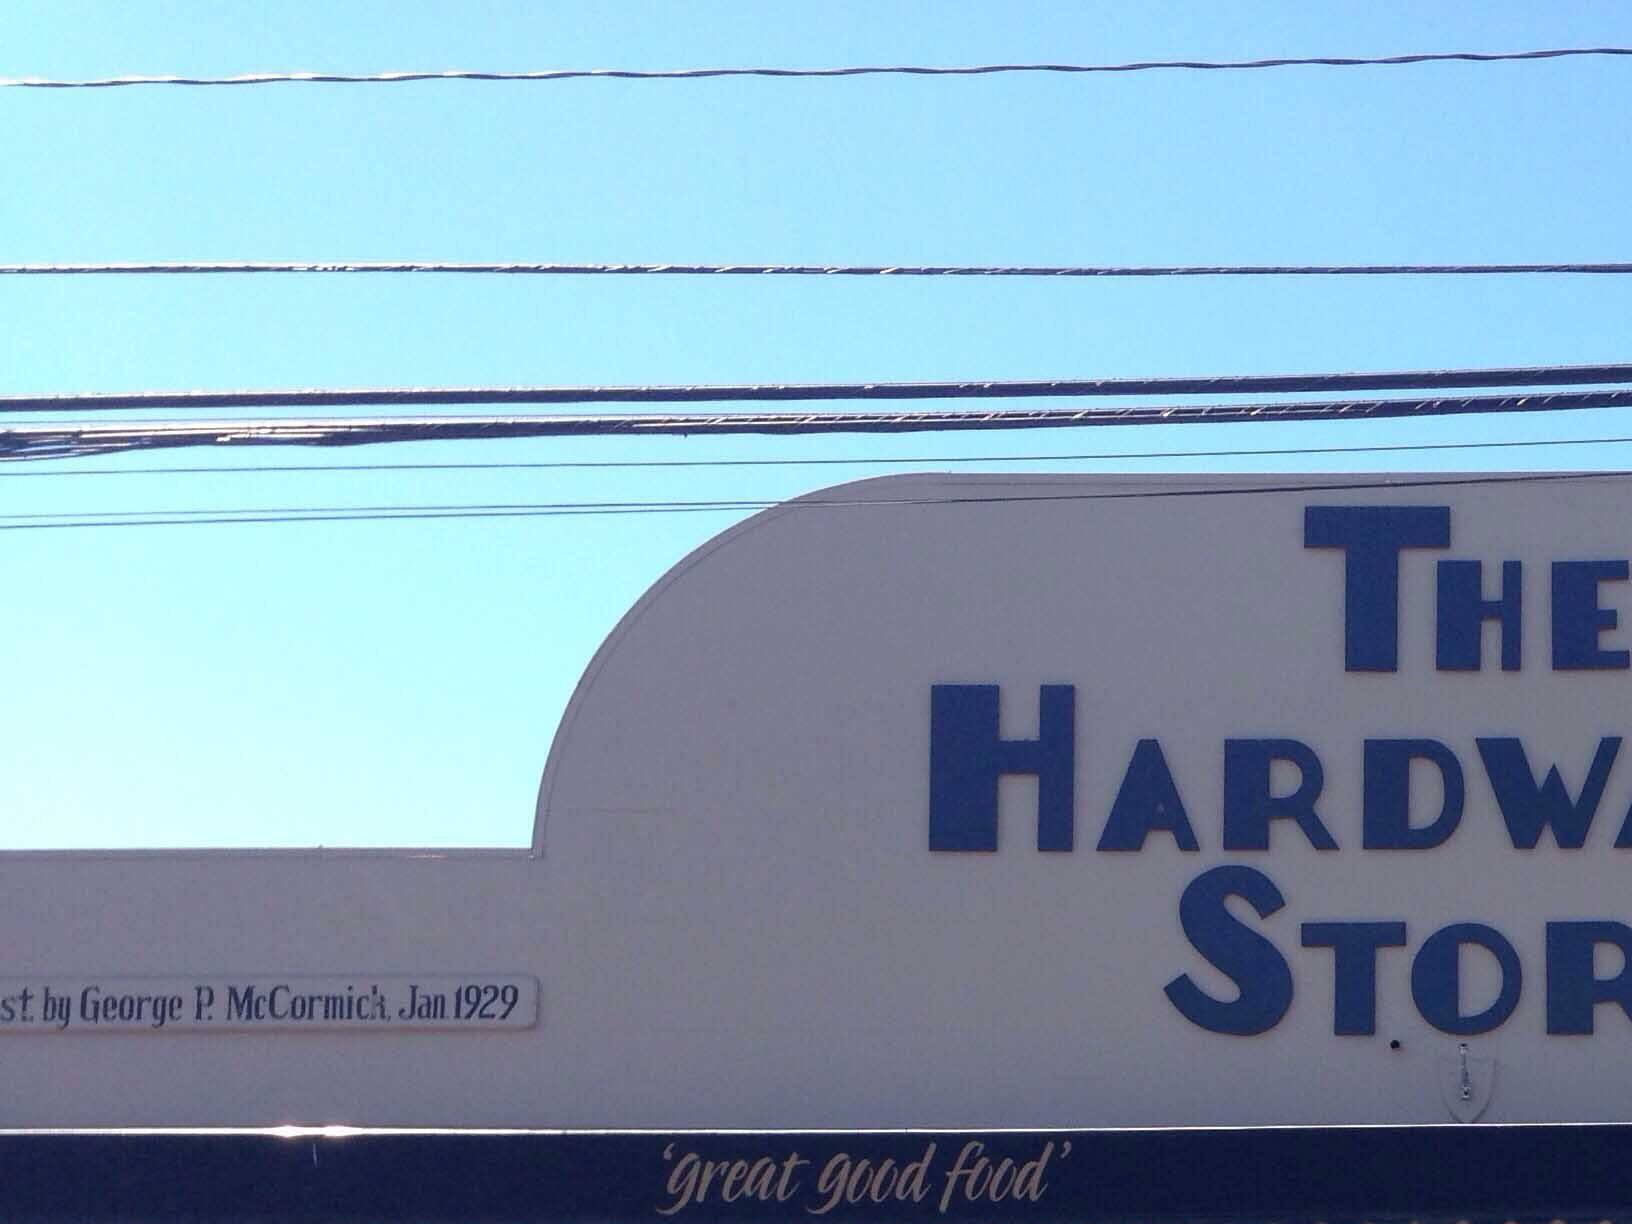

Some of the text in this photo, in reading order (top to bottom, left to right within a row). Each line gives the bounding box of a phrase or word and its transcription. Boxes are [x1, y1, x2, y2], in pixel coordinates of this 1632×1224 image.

[1304, 506, 1630, 672] THE
[42, 985, 72, 1031] by
[80, 985, 184, 1029] George
[194, 985, 213, 1021] P.
[454, 984, 519, 1020] 1929
[807, 1143, 937, 1215] good
